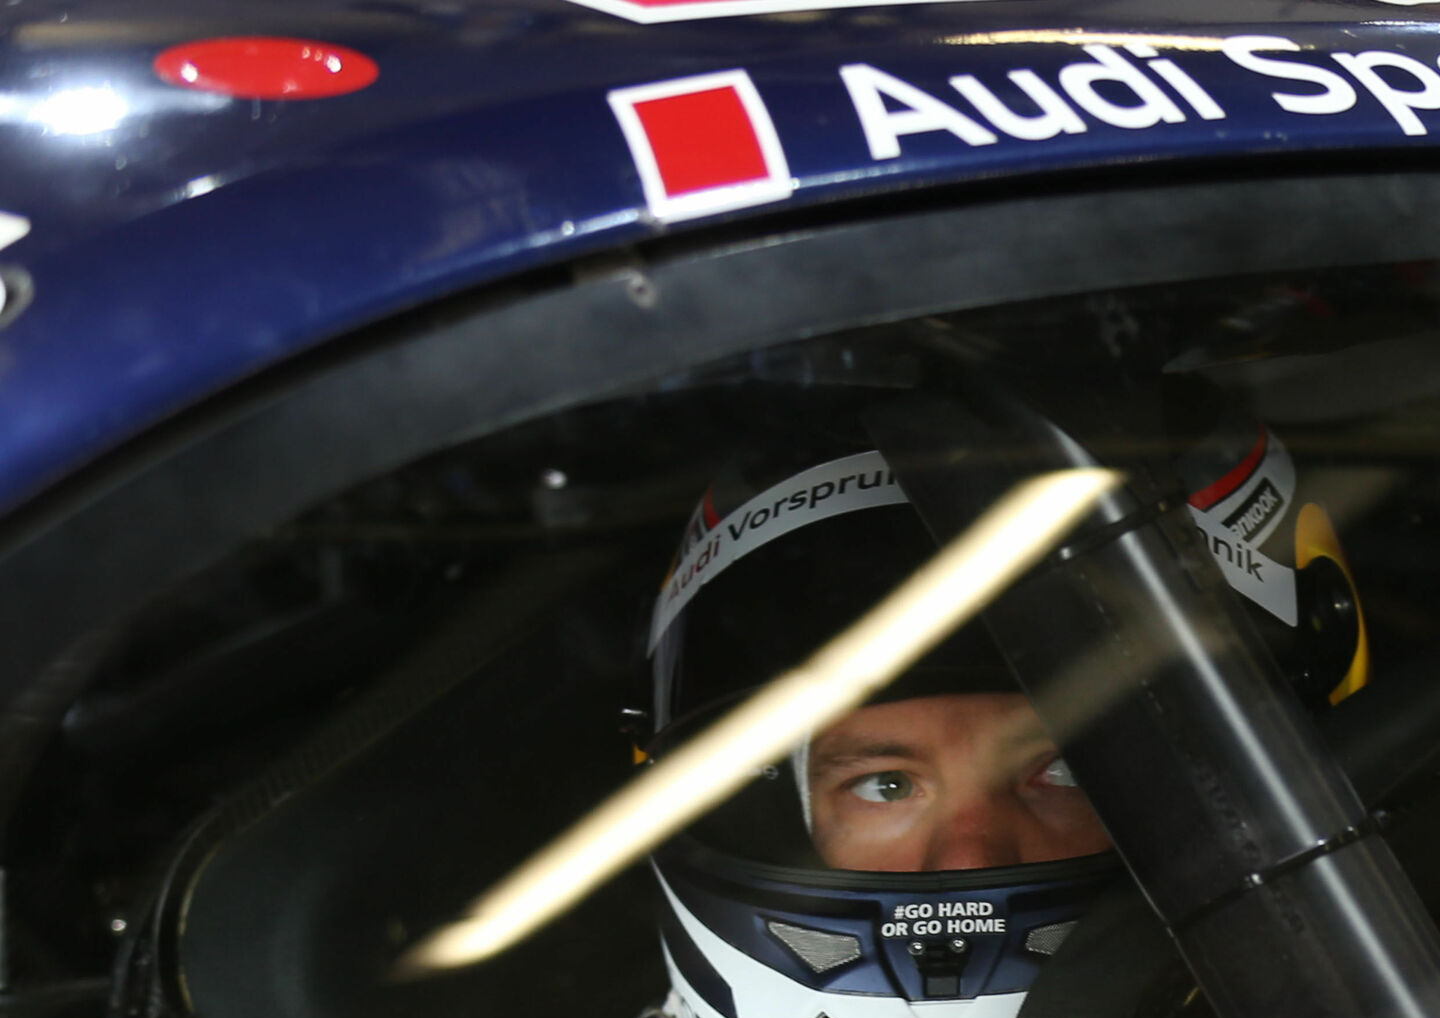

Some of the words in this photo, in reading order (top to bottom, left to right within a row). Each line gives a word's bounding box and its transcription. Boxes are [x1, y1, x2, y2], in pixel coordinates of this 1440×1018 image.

[838, 43, 1227, 161] Audi
[668, 534, 721, 606] Audi
[881, 922, 909, 938] OR
[912, 920, 942, 936] GO
[947, 918, 1006, 934] HOME
[894, 904, 934, 920] #GO
[938, 902, 994, 918] HARD
